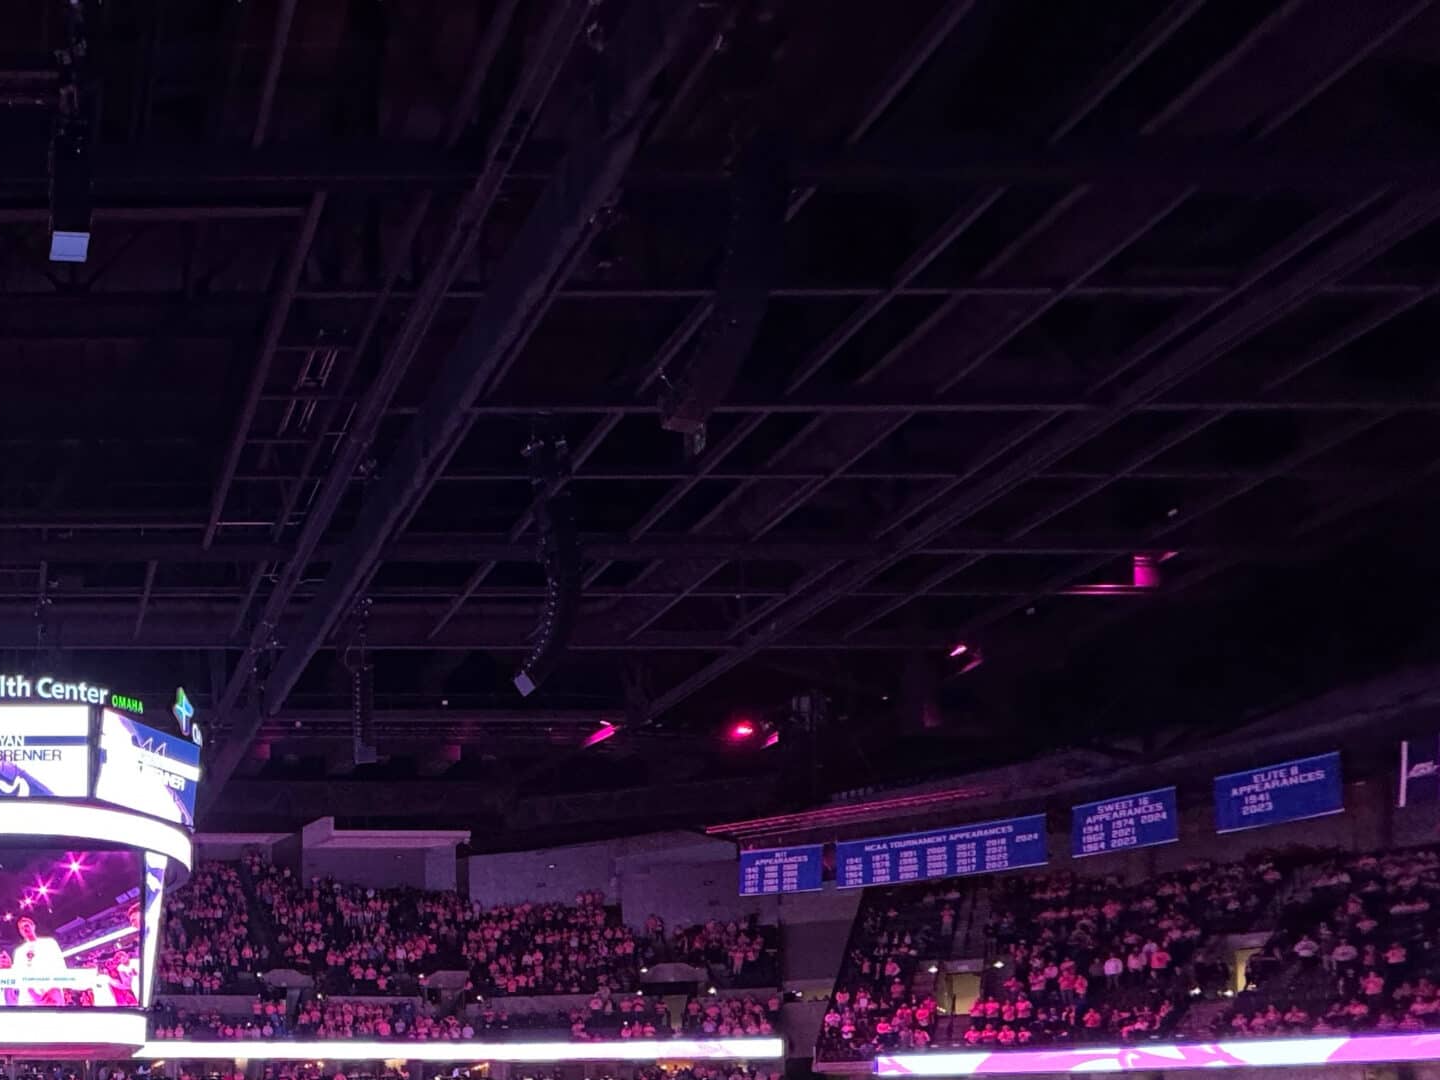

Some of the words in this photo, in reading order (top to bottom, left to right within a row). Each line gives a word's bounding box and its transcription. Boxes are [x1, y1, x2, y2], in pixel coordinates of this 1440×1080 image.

[36, 678, 109, 704] Center
[111, 694, 144, 714] OMAHA
[1231, 769, 1326, 797] APPEARANCES
[1252, 768, 1288, 784] ELITE
[1097, 800, 1134, 815] SWEET
[1138, 796, 1149, 806] 16
[1244, 792, 1270, 805] 1941
[1086, 802, 1164, 825] APPEARANCES
[1241, 801, 1273, 816] 2023
[1083, 823, 1104, 834] 1941
[1112, 818, 1135, 830] 1974
[1140, 811, 1168, 825] 2024
[864, 843, 888, 851] NCAA
[889, 835, 947, 849] TOURNAMENT
[948, 825, 1014, 841] APPEARANCES
[1015, 832, 1038, 843] 2024
[1111, 827, 1135, 839] 2021
[1110, 836, 1137, 849] 2023
[755, 855, 809, 866] APPEARANCES
